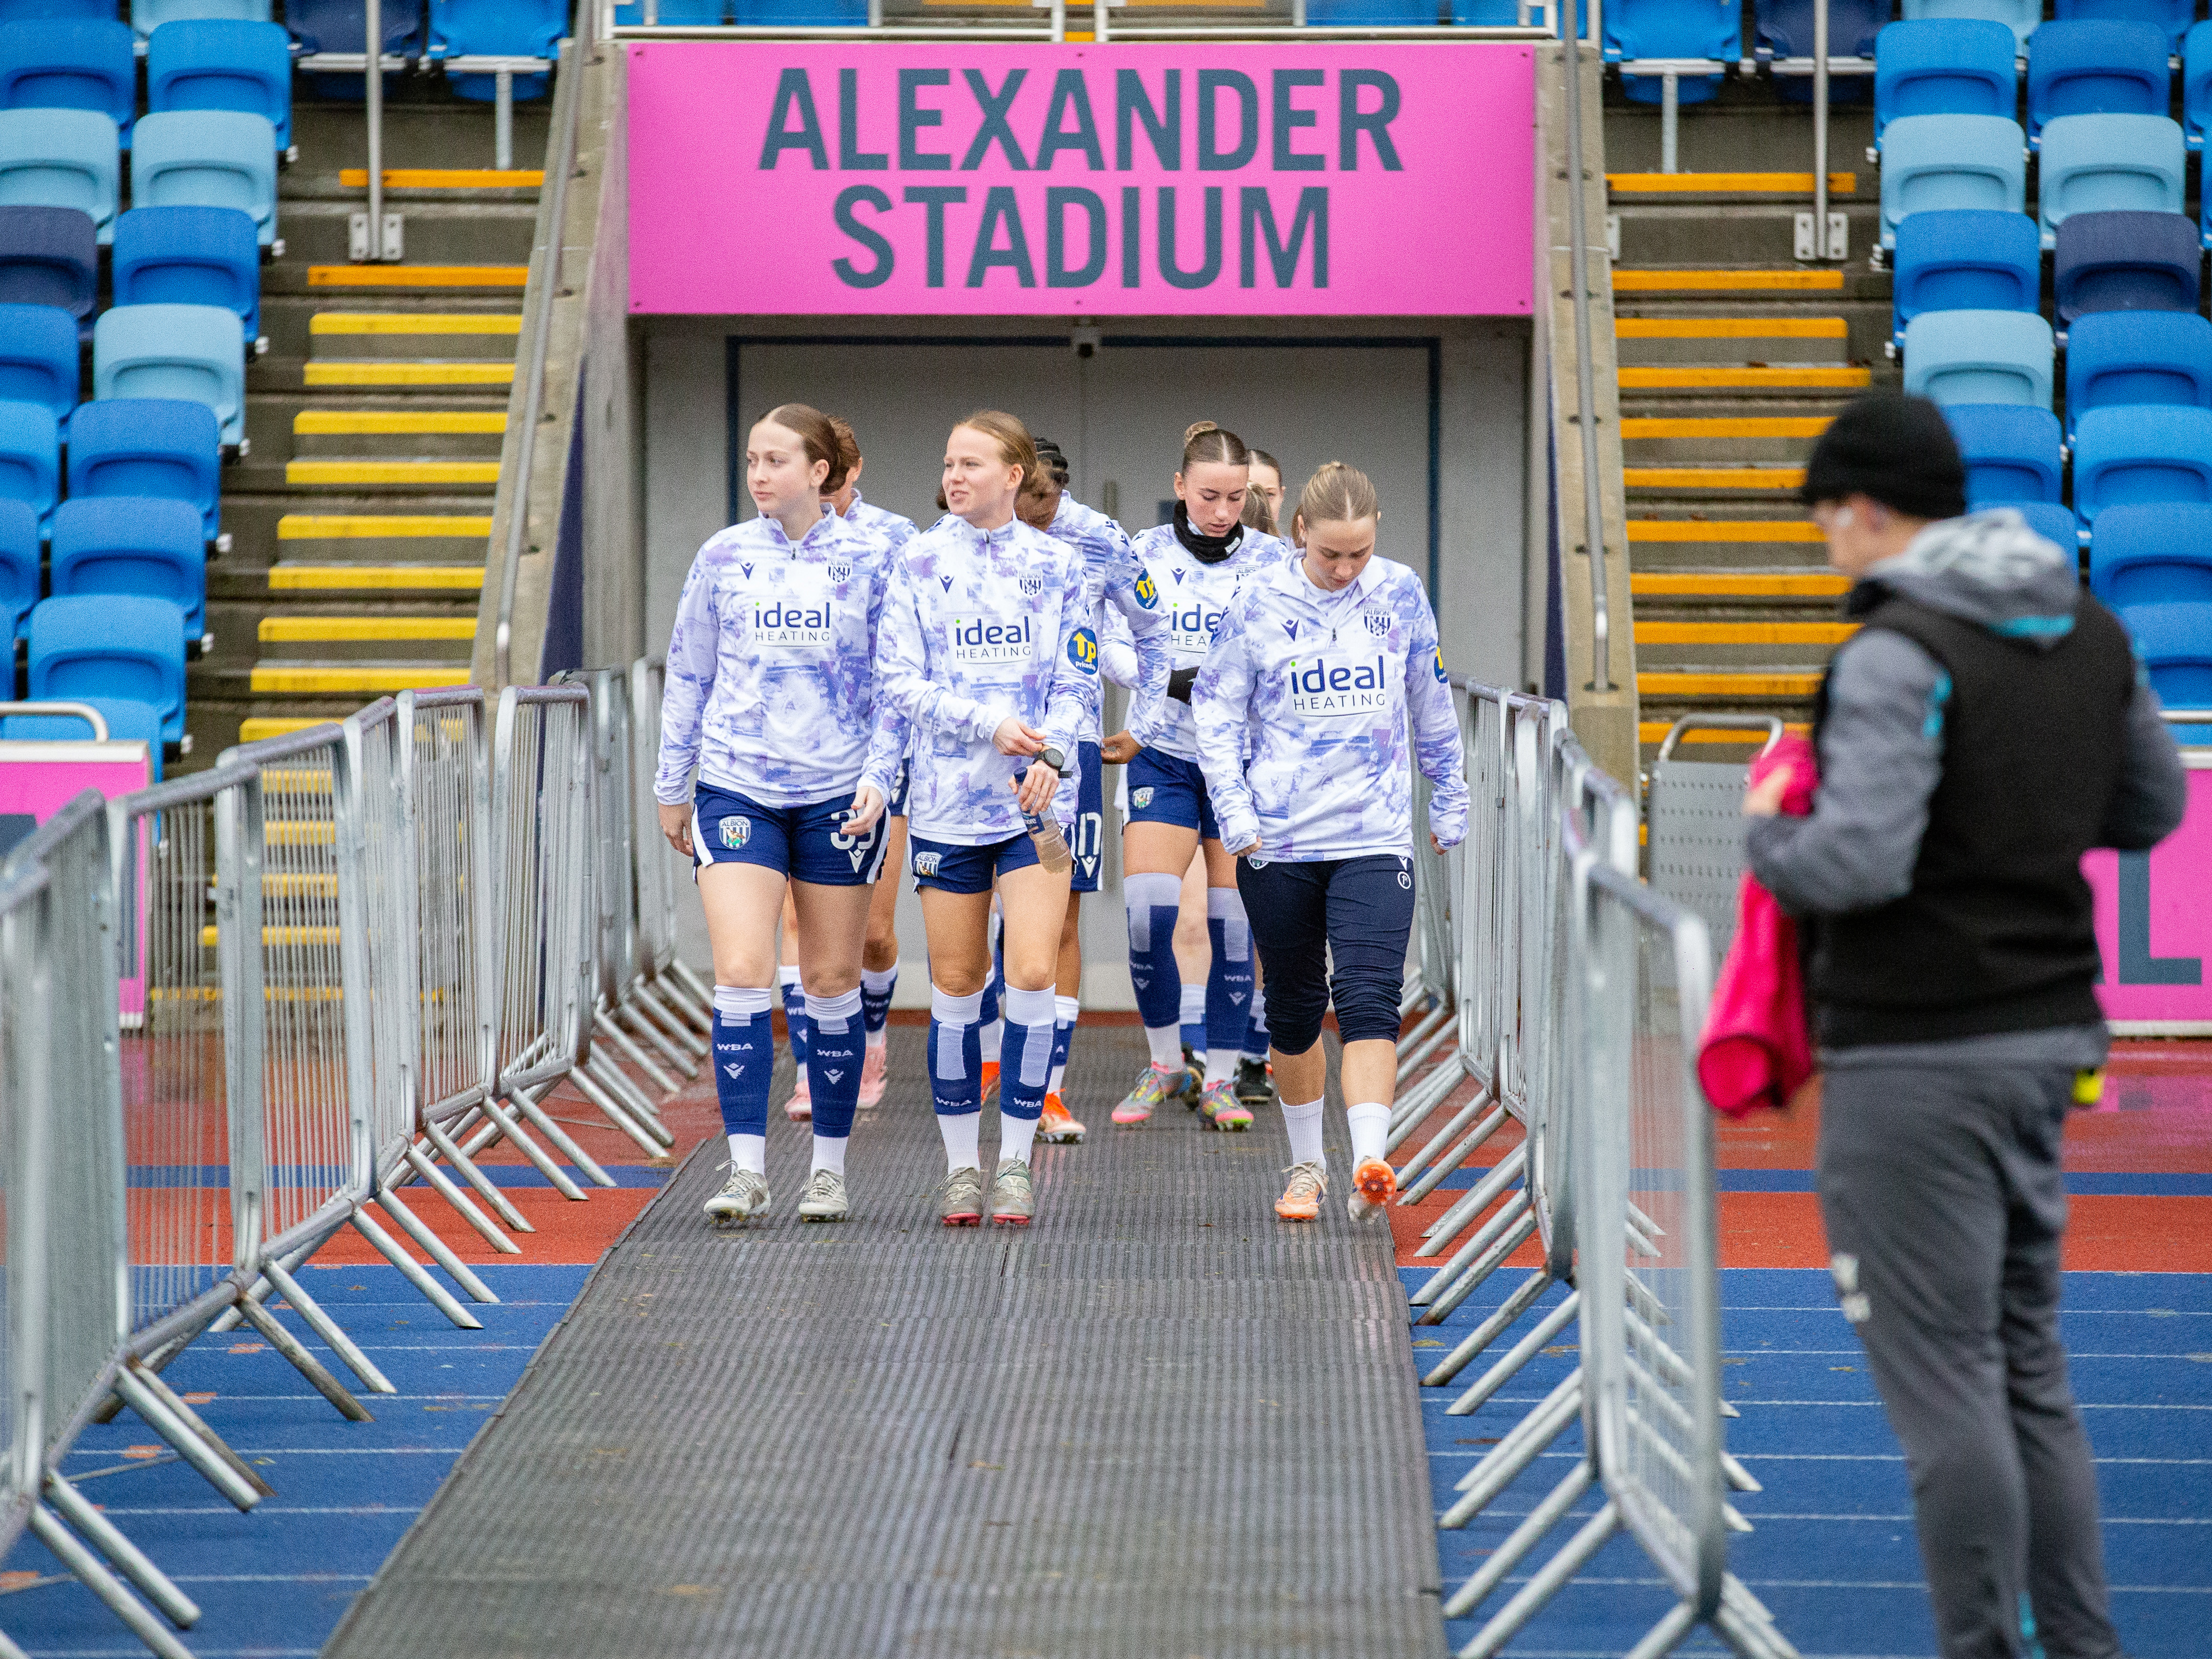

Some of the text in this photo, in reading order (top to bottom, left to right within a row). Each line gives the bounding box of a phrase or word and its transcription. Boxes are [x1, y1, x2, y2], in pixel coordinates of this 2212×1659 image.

[759, 68, 1403, 171] ALEXANDER
[832, 185, 1329, 289] STADIUM
[755, 602, 830, 628] ideal
[1172, 603, 1221, 632] ide
[755, 631, 830, 641] HEATING
[955, 615, 1030, 646] ideal
[957, 646, 1031, 658] HEATING
[1291, 655, 1384, 694] ideal
[1294, 693, 1384, 710] HEATING
[787, 1007, 806, 1015] WB
[717, 1042, 753, 1051] WBA
[817, 1049, 854, 1057] WBA
[935, 1096, 972, 1107] WBA
[1013, 1097, 1042, 1108] WBA
